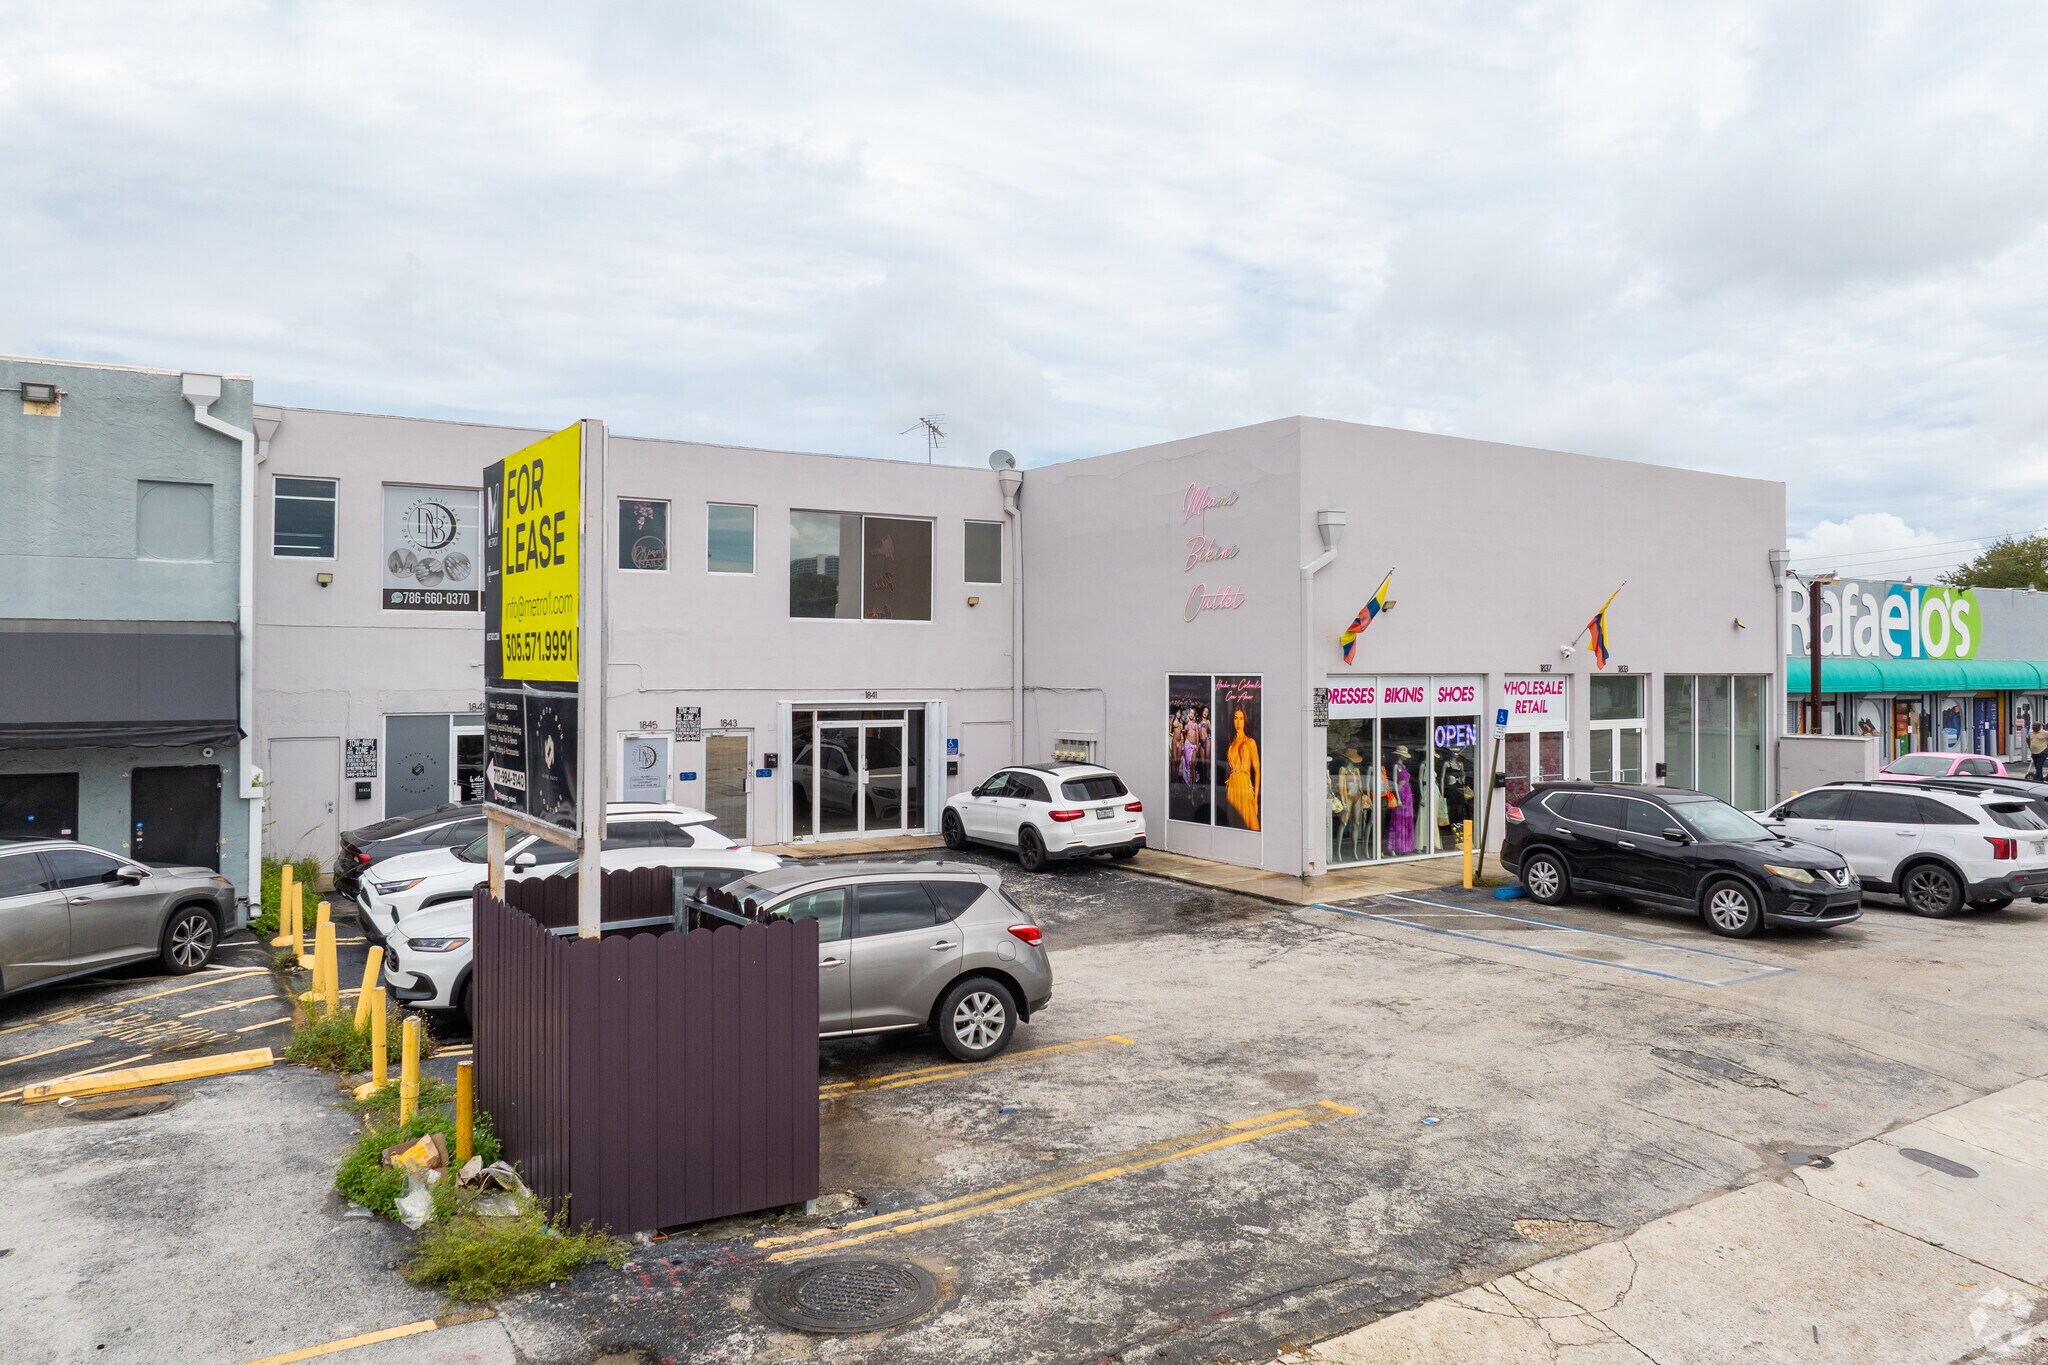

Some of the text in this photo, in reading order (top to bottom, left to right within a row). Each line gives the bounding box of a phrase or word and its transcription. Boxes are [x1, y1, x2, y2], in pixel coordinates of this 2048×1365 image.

[507, 458, 544, 519] FOR
[1183, 483, 1239, 524] Miami
[506, 511, 566, 575] LEASE
[1184, 535, 1240, 572] Bikini
[403, 592, 469, 605] 786-660-0370
[506, 590, 573, 622] info@metro1.com
[1184, 583, 1245, 622] Outlet
[1786, 578, 1971, 658] Rafaelo's
[506, 629, 573, 661] 305.571.9991
[1540, 664, 1552, 672] 1837
[865, 691, 878, 699] 1841
[1328, 687, 1375, 704] DRESSES
[1384, 686, 1424, 704] BIKINIS
[1437, 686, 1475, 703] SHOES
[1504, 681, 1564, 696] WHOLESALE
[1515, 700, 1549, 714] RETAIL
[640, 721, 658, 729] 1845
[720, 719, 738, 728] 1843
[1434, 723, 1477, 748] OPEN
